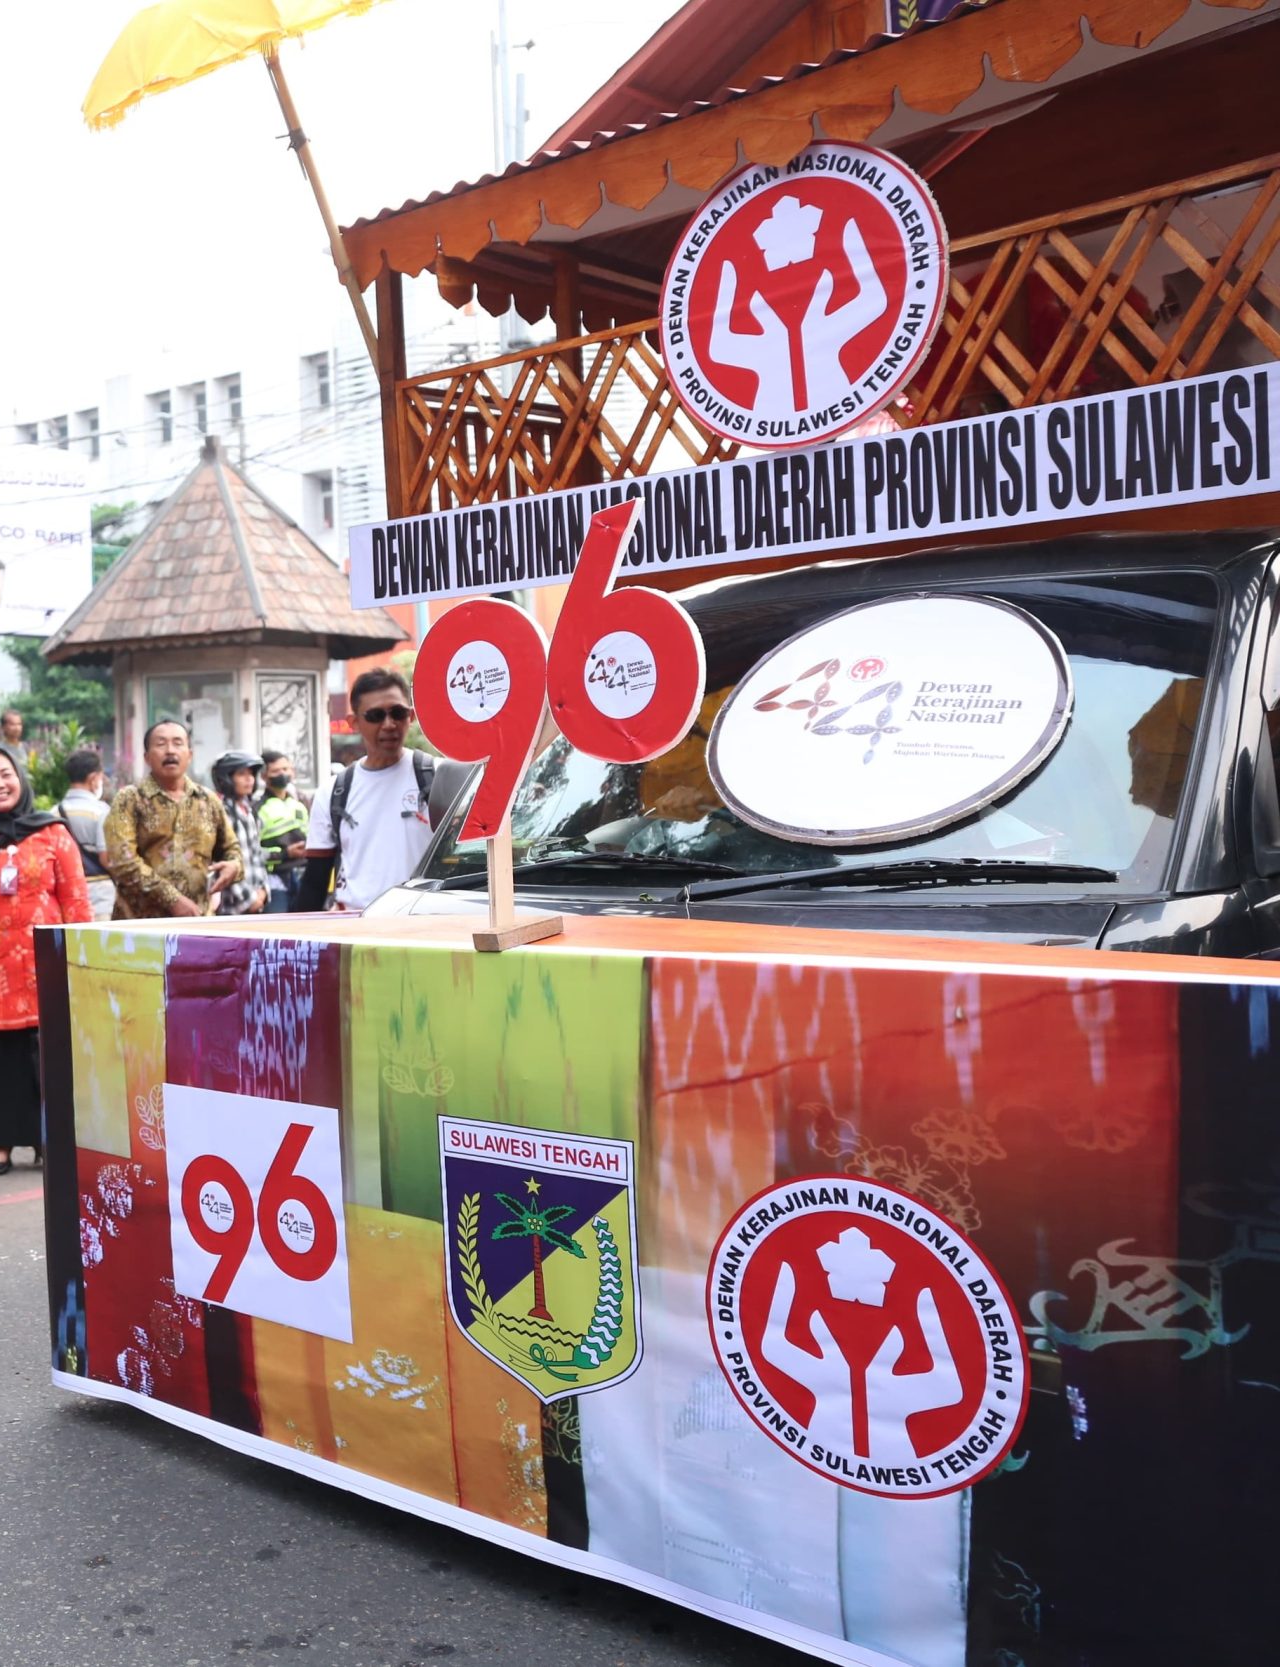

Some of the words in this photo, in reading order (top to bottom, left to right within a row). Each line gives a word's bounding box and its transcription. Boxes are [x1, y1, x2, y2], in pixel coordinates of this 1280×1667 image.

[668, 268, 691, 346] DEWAN
[682, 165, 781, 263] KERAJINAN
[786, 153, 885, 192] NASIONAL
[886, 185, 930, 272] DAERAH
[679, 366, 753, 434] PROVINSI
[756, 390, 865, 438] SULAWESI
[863, 303, 927, 394] TENGAH
[372, 515, 451, 600] DEWAN
[454, 491, 585, 589] KERAJINAN
[732, 444, 857, 552] DAERAH
[864, 412, 1038, 534] PROVINSI
[1047, 370, 1271, 511] SULAWESI
[413, 498, 705, 843] 96
[905, 709, 1006, 725] Nasional
[912, 695, 1023, 710] Kerajinan
[917, 681, 993, 694] Dewan
[181, 1122, 338, 1304] 96
[450, 1130, 537, 1160] SULAWESI
[542, 1143, 620, 1172] TENGAH
[717, 1245, 746, 1323] DEWAN
[737, 1187, 849, 1246] KERAJINAN
[857, 1190, 970, 1277] NASIONAL
[967, 1279, 1013, 1383] DAERAH
[726, 1352, 808, 1450] PROVINSI
[810, 1444, 932, 1487] SULAWESI
[931, 1408, 1007, 1480] TENGAH
